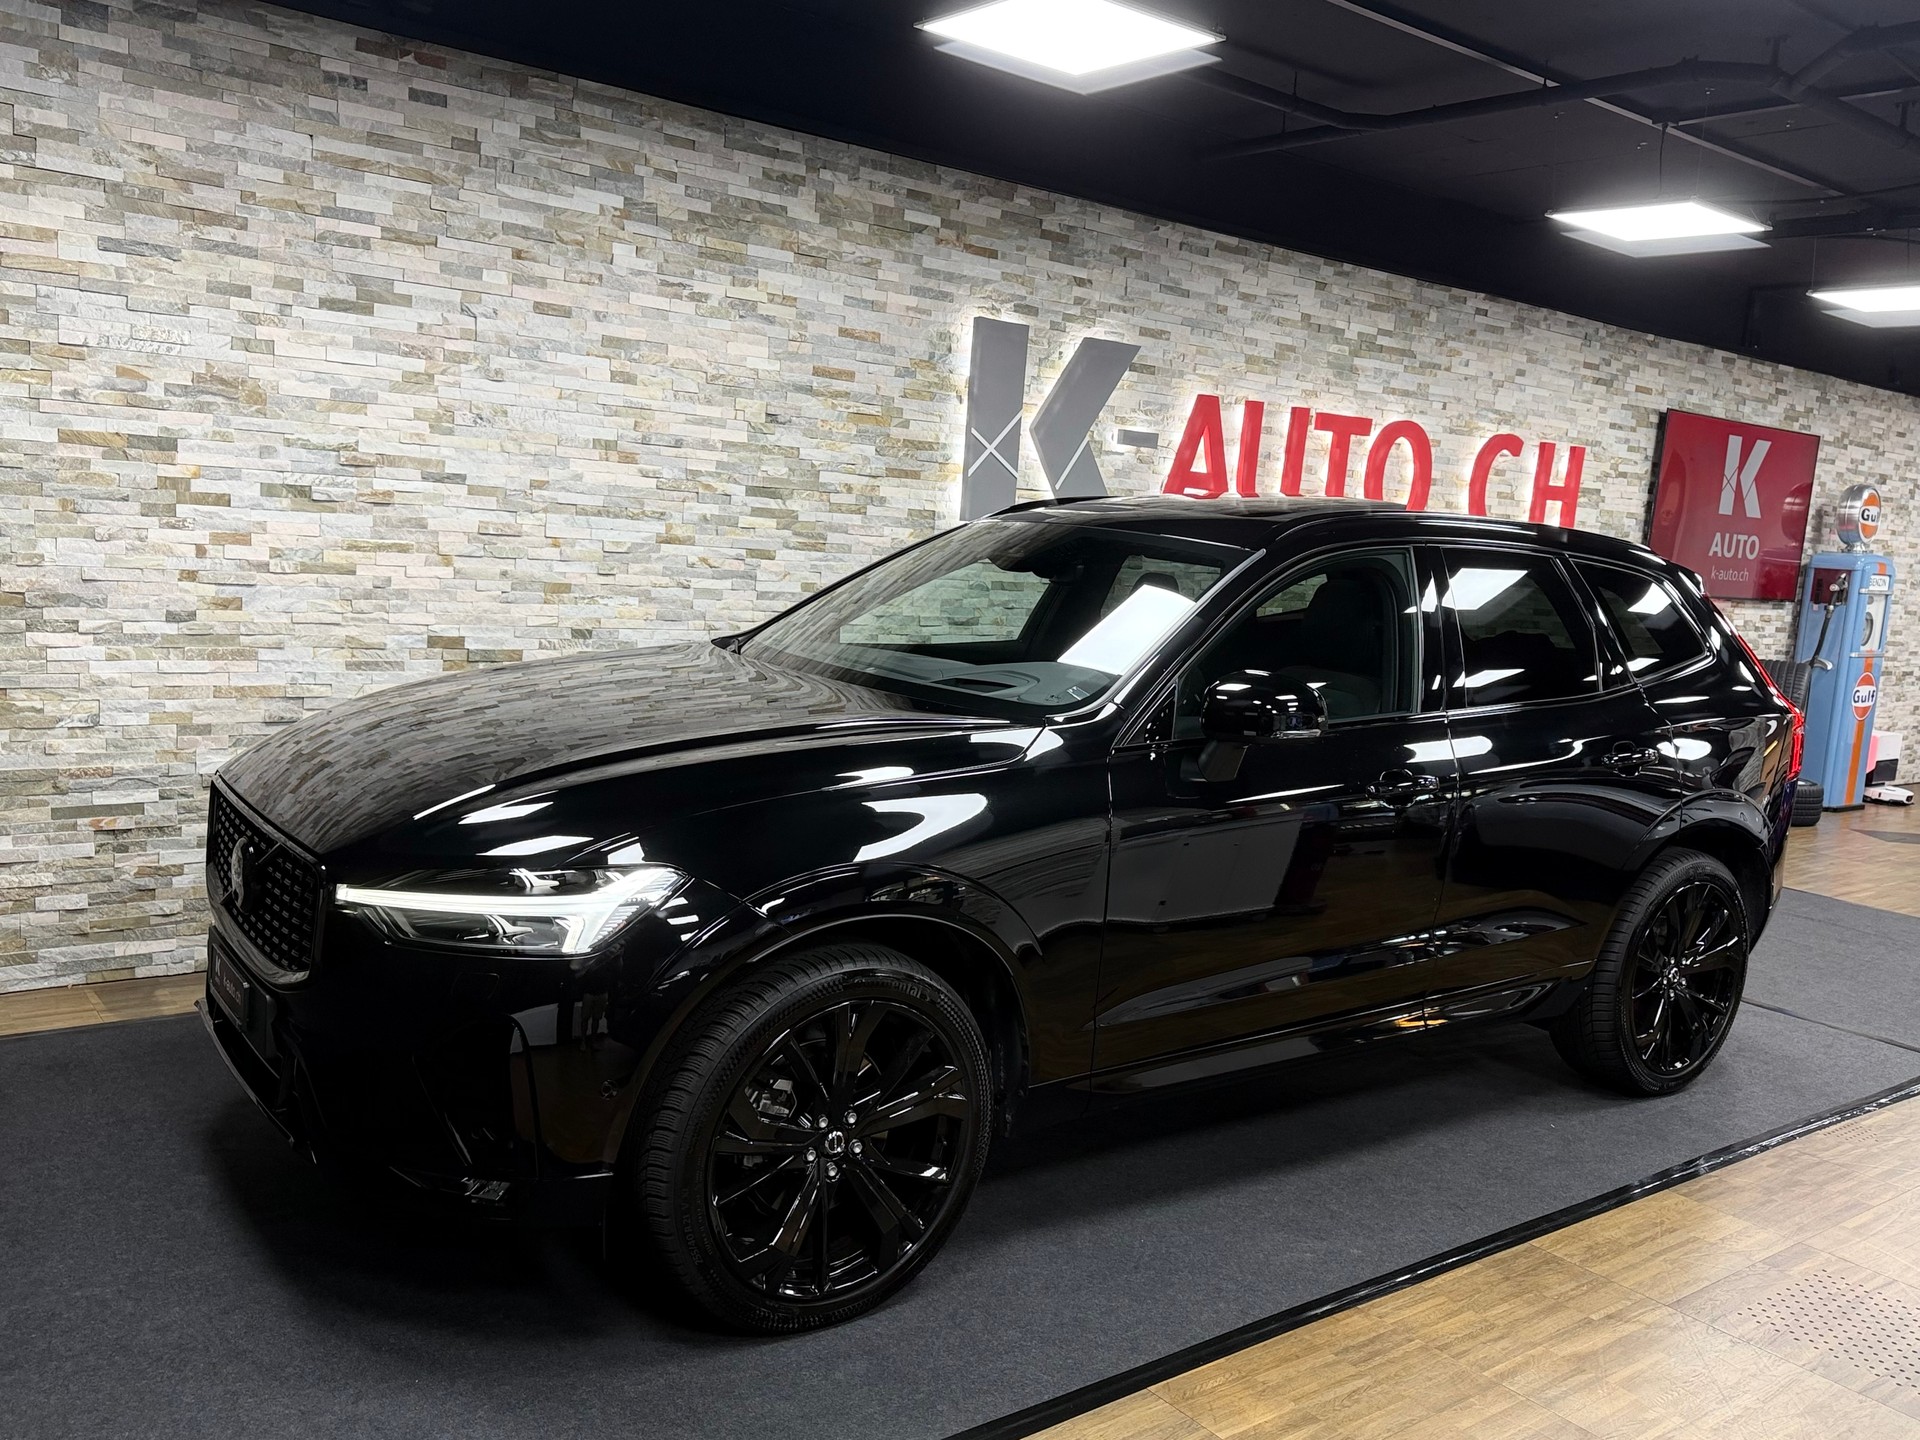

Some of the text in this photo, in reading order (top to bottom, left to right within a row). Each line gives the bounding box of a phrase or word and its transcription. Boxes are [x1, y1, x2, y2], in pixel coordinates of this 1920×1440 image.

[1718, 434, 1772, 519] K
[1708, 532, 1760, 560] AUTO
[1711, 566, 1749, 582] k-auto.ch
[1853, 689, 1876, 704] Gulf
